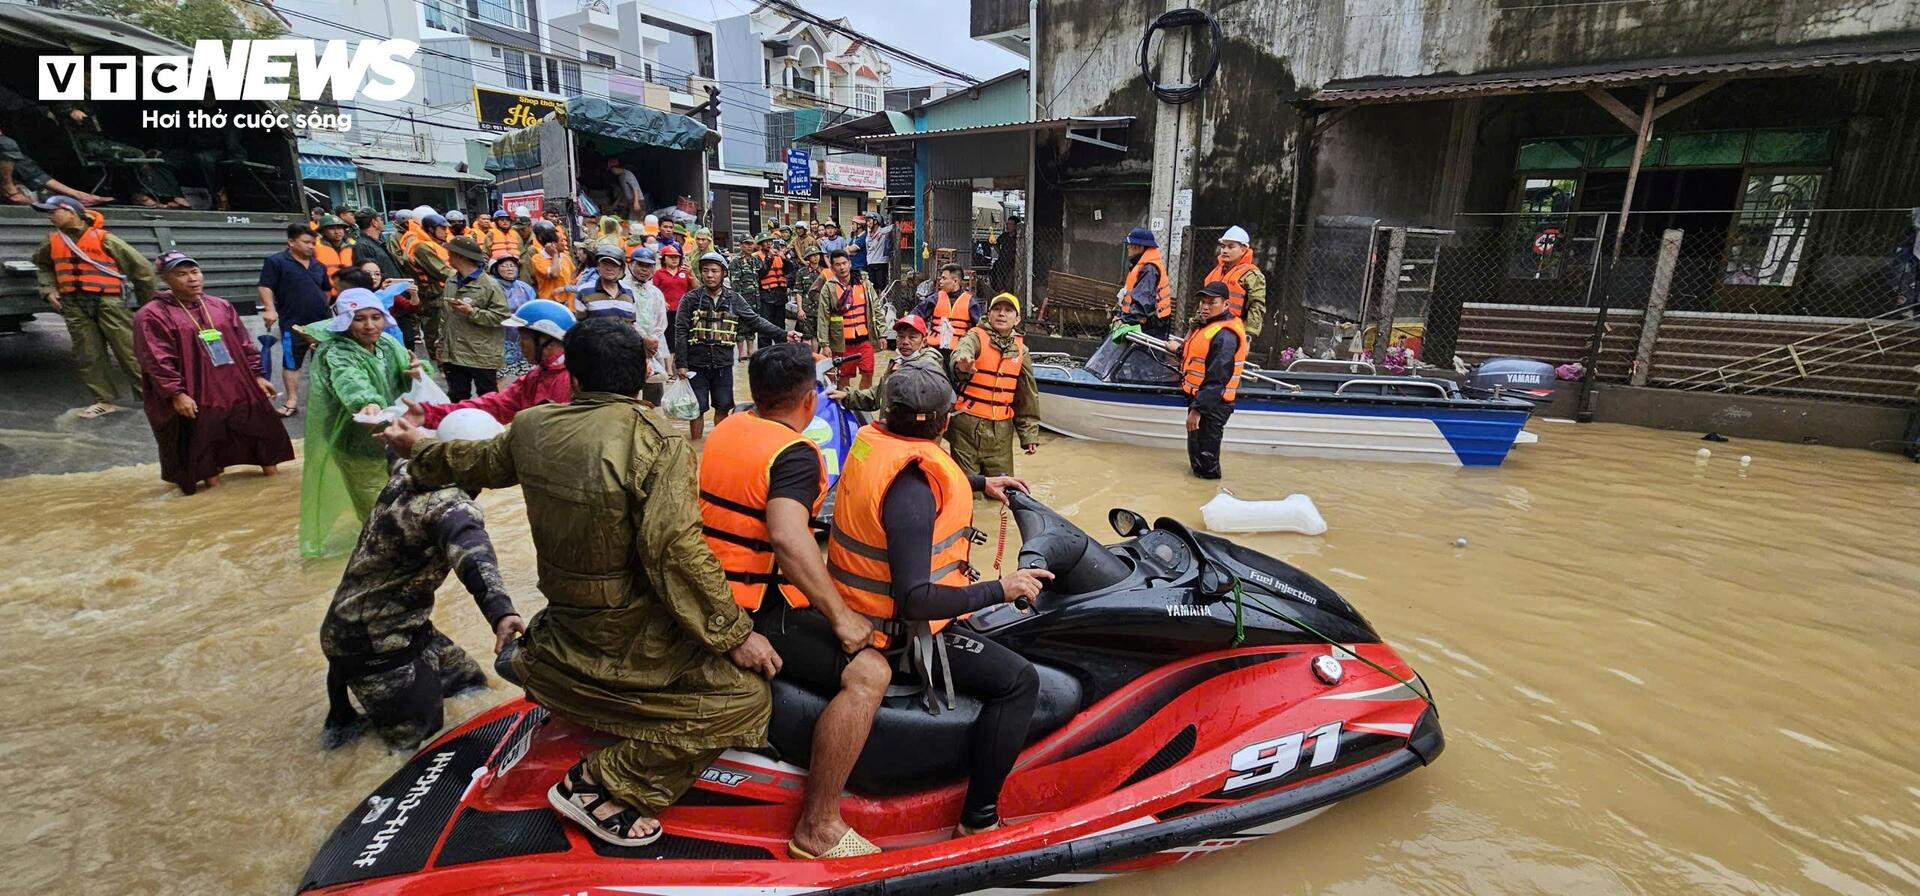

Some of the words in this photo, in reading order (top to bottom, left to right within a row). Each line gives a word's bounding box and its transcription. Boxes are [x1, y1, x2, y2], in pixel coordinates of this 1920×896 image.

[1507, 374, 1541, 384] YAMAHA
[1249, 571, 1274, 586] Fuel
[1274, 579, 1318, 605] Injection
[1165, 604, 1213, 617] YAMAHA
[1223, 721, 1345, 793] 91
